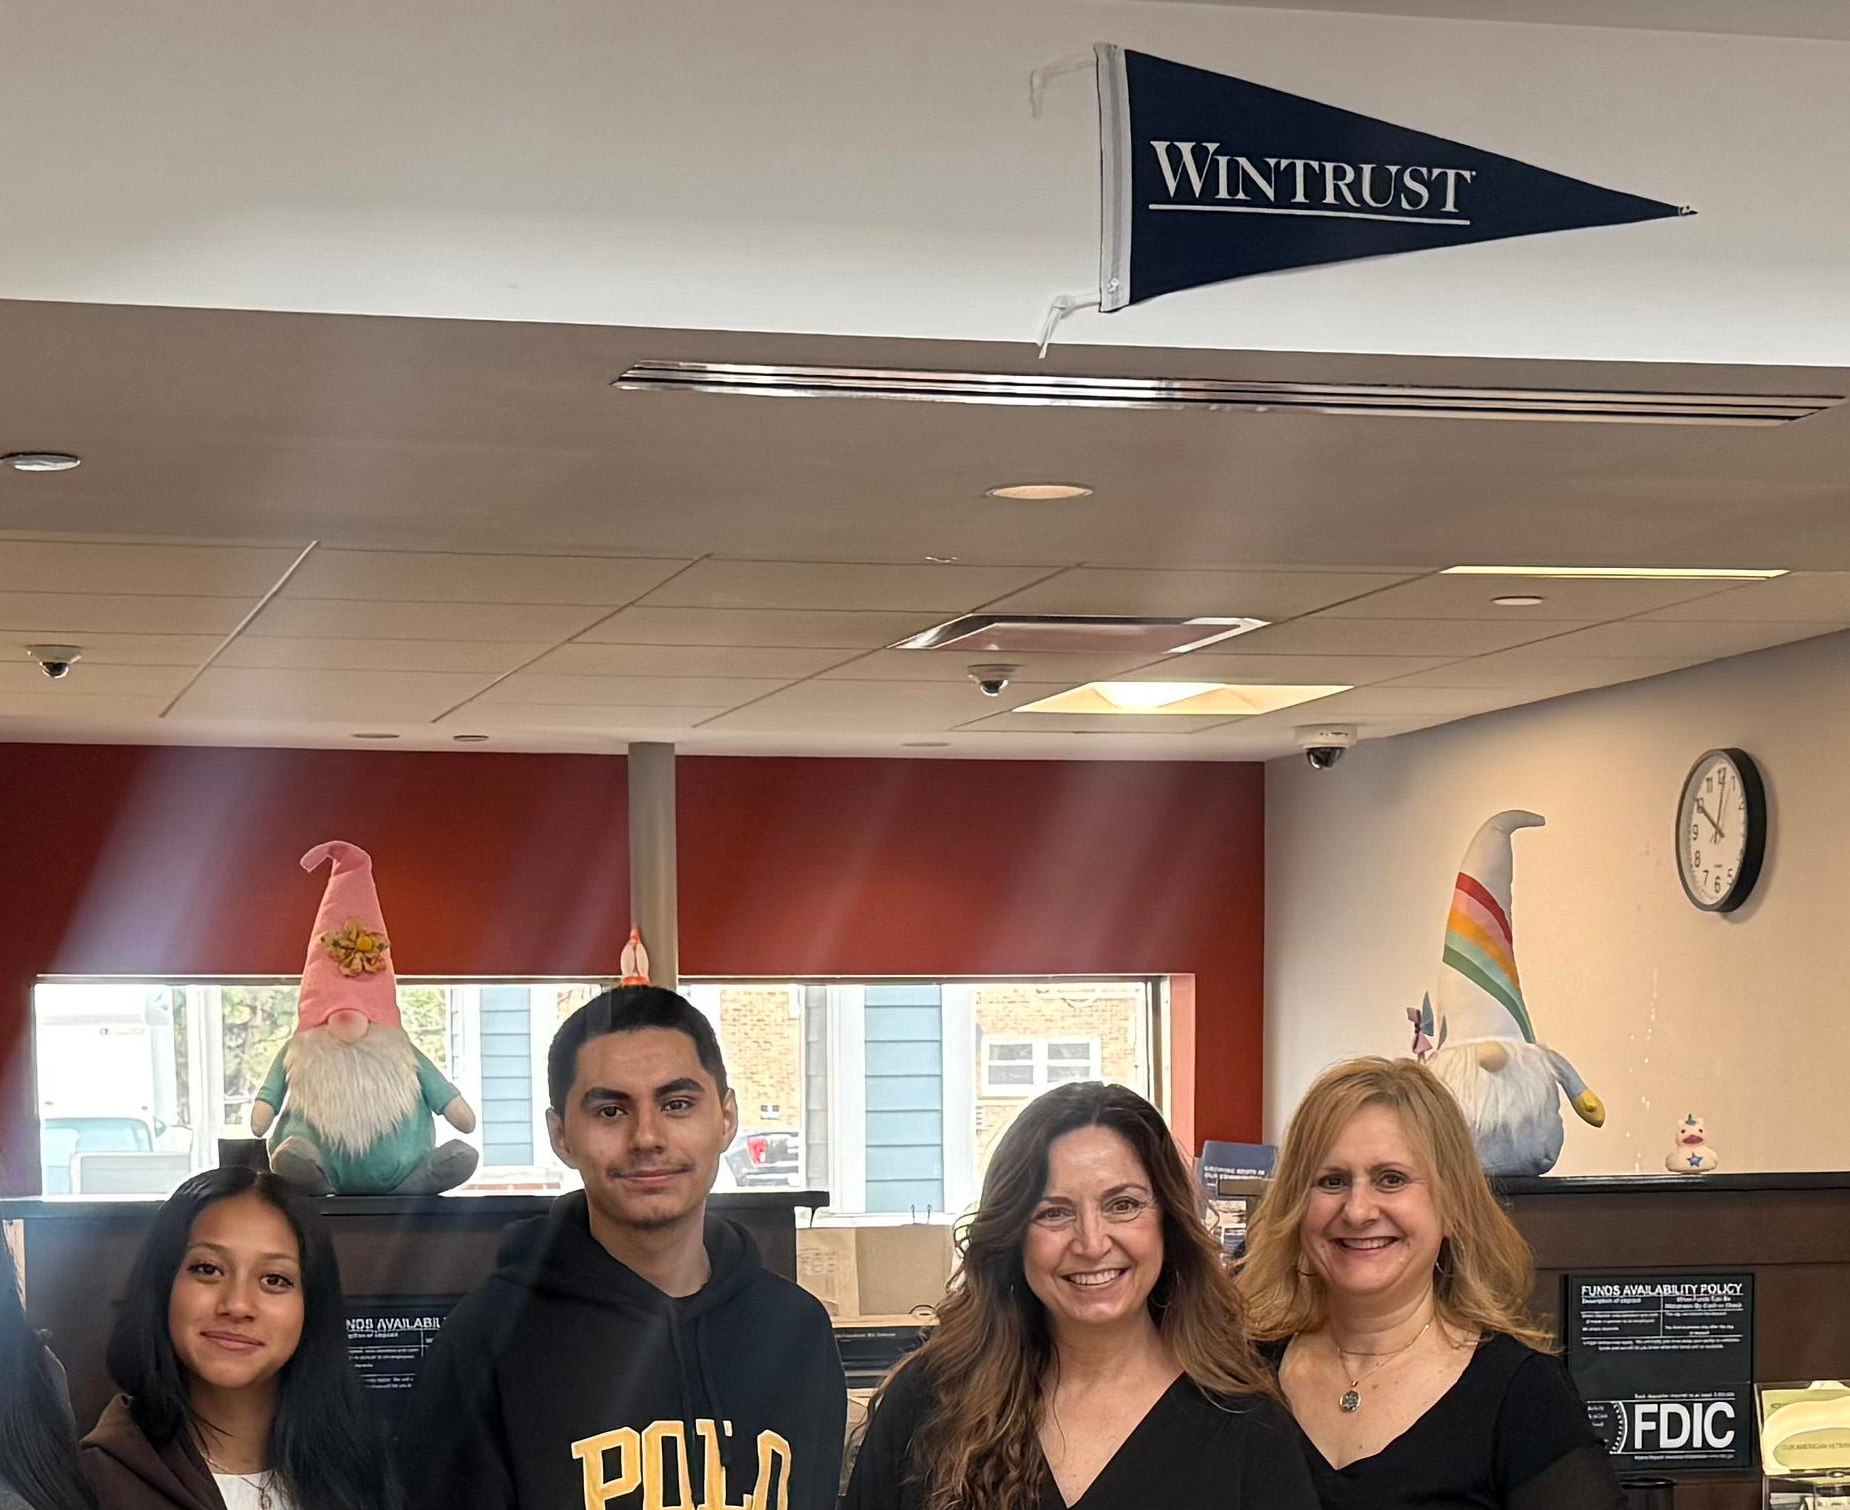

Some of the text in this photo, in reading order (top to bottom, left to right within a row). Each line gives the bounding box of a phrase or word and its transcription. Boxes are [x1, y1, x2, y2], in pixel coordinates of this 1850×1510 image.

[1150, 140, 1476, 213] WINTRUST
[1692, 824, 1699, 841] 9
[1694, 850, 1700, 867] 8
[1703, 870, 1709, 886] 7
[1714, 876, 1721, 893] 6
[1582, 1284, 1742, 1296] FUNDS AVAILABILITY POLICY
[1635, 1402, 1735, 1449] FDIC
